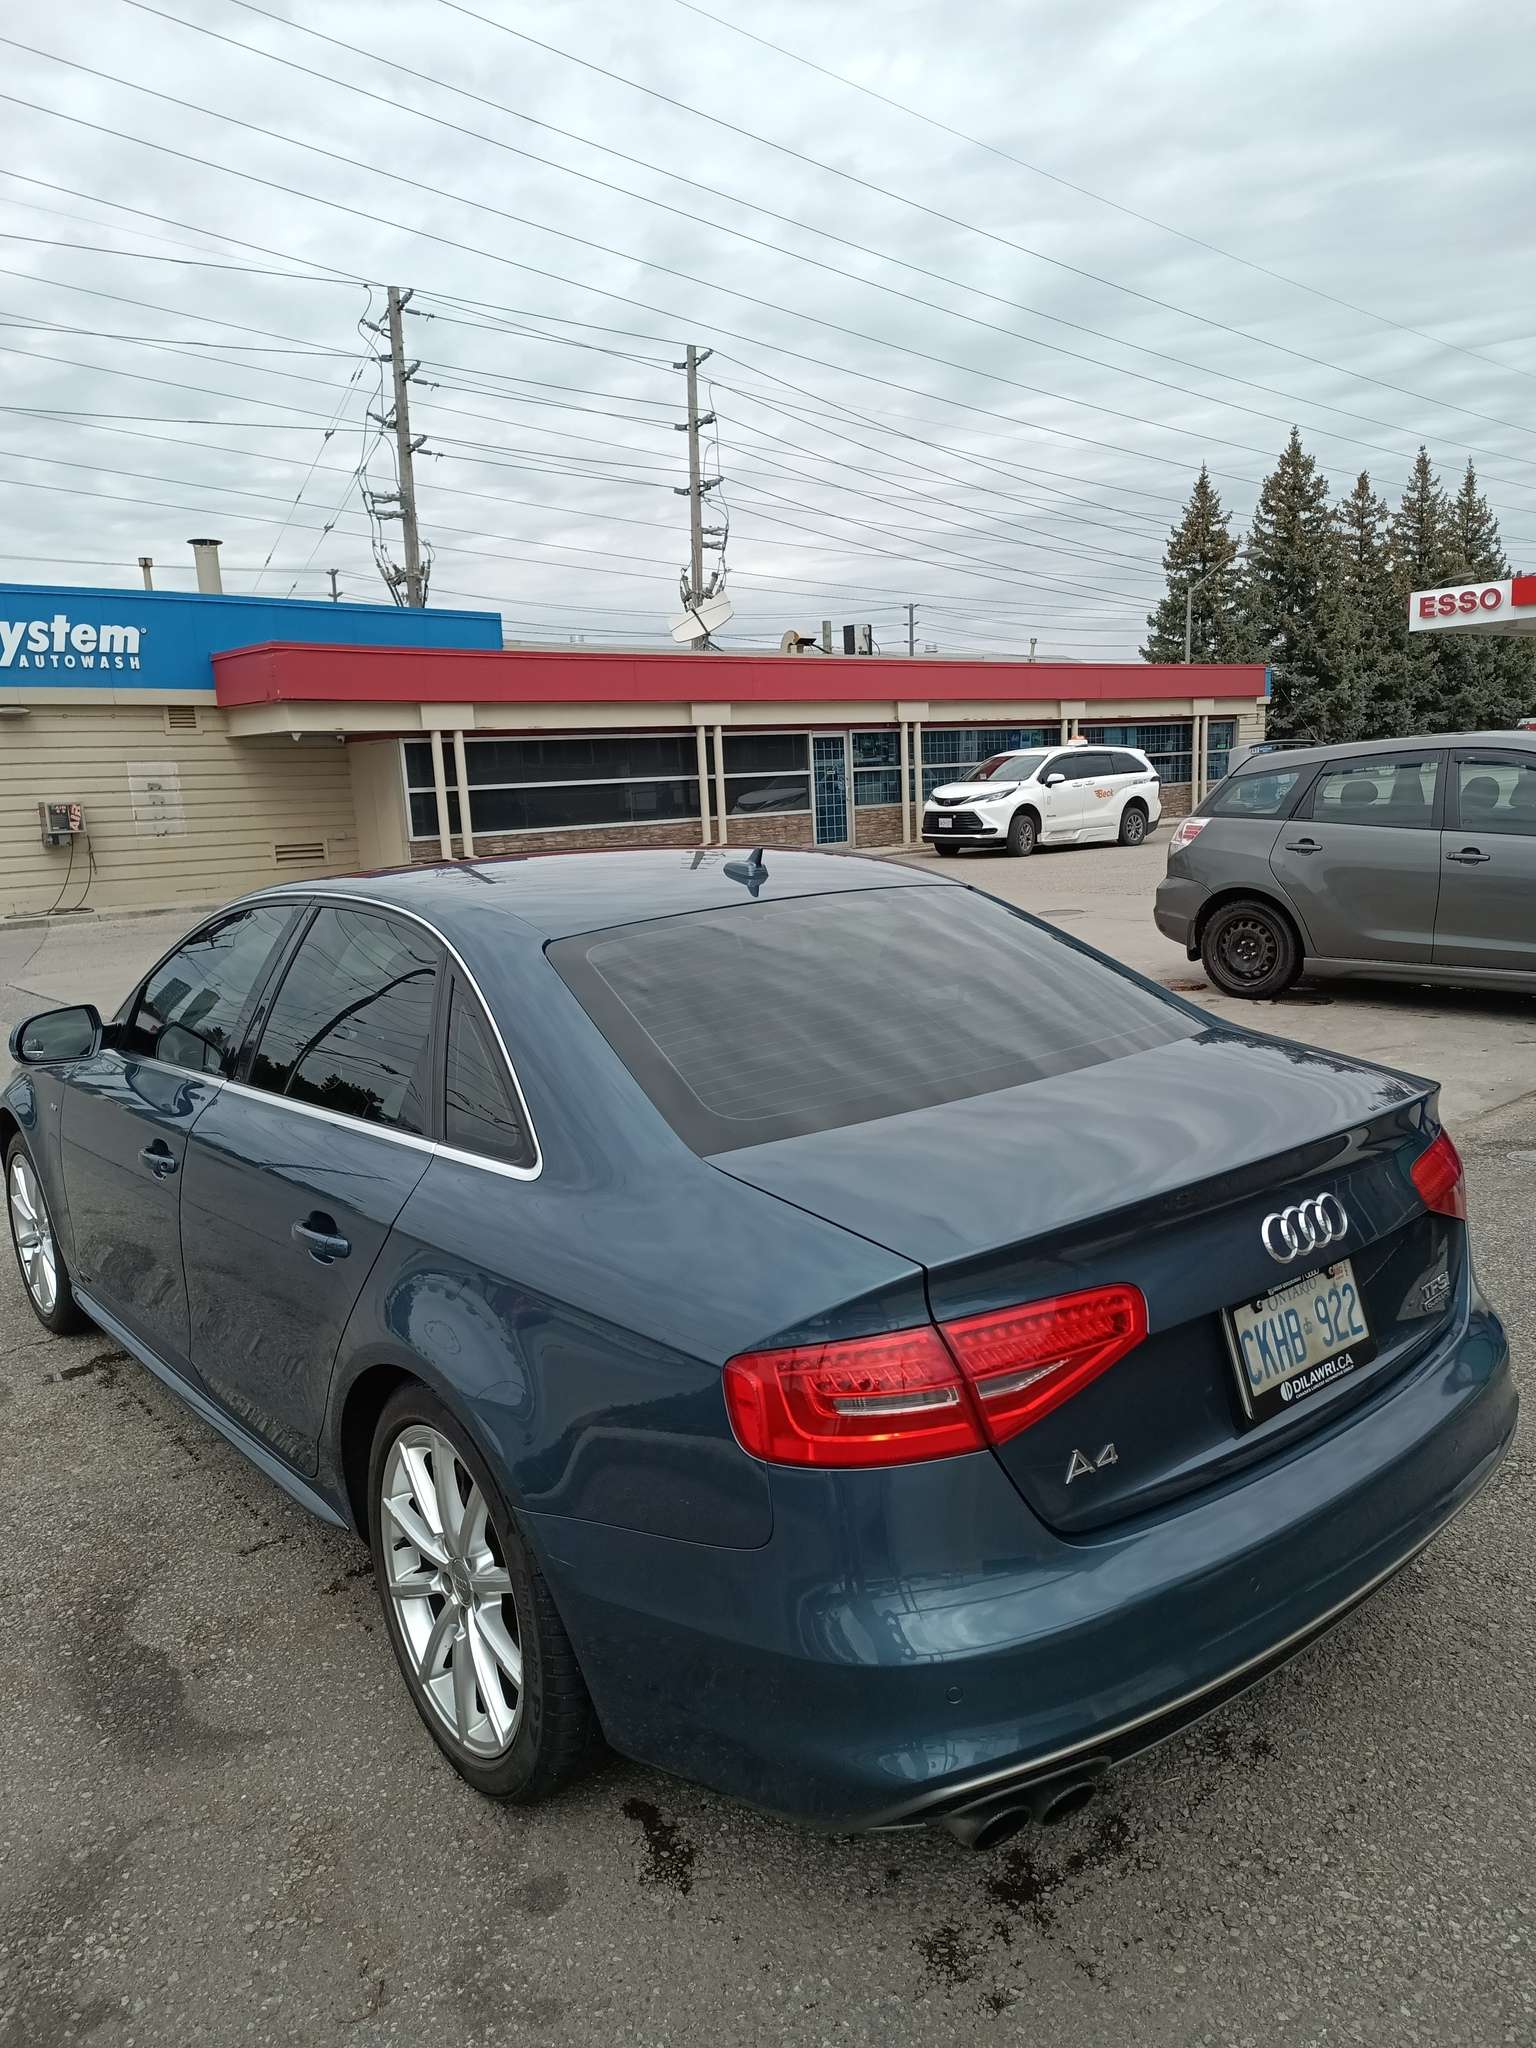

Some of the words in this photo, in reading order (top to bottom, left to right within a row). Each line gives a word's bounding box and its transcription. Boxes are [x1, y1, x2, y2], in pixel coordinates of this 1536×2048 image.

[1419, 587, 1502, 618] ESSO
[19, 654, 140, 669] AUTOWASH
[1241, 1308, 1307, 1385] CKHB
[1314, 1283, 1364, 1347] 922
[1292, 1353, 1354, 1393] DILAWRI.CA
[1065, 1443, 1119, 1484] A4
